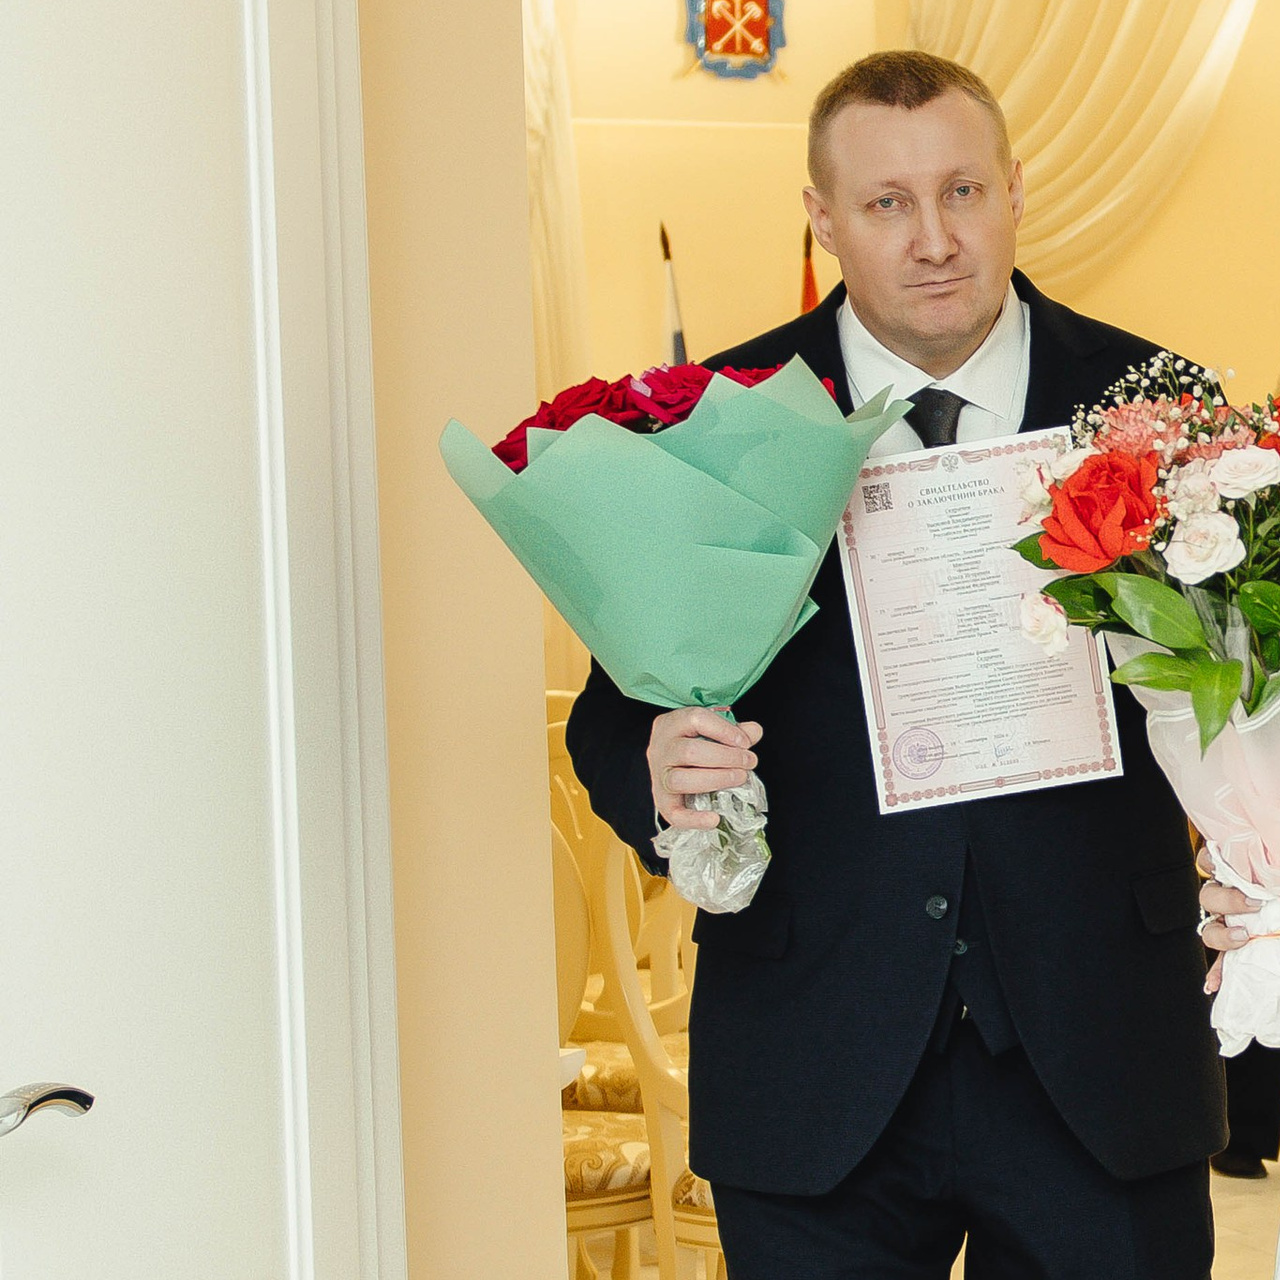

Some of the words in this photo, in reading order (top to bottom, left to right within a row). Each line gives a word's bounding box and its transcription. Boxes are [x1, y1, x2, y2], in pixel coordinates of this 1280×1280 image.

[917, 491, 976, 507] ЗАКЛЮЧЕНИИ
[979, 486, 1005, 497] БРАКА
[920, 479, 990, 497] СВИДЕТЕЛЬСТВО
